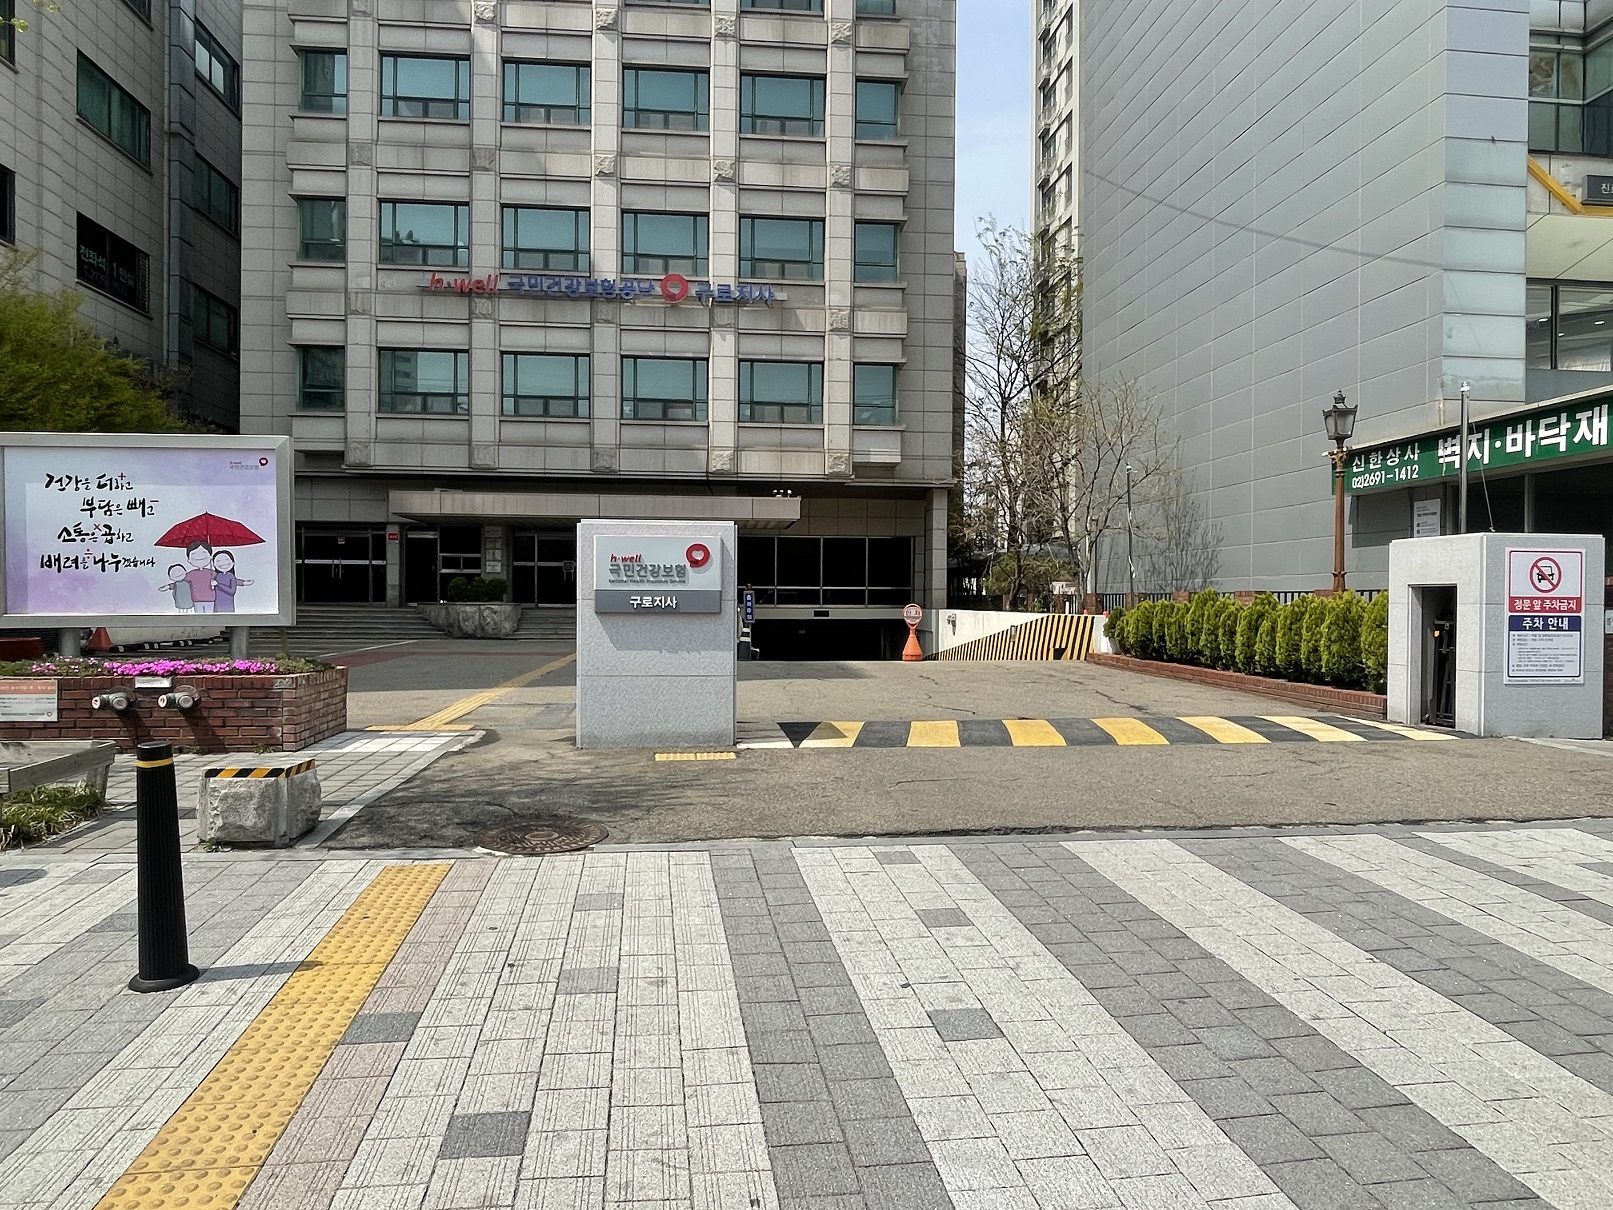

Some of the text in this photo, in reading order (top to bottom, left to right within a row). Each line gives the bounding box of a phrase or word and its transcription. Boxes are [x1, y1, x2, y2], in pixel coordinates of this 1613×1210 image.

[507, 273, 655, 300] 국민건강보험공단
[695, 282, 774, 304] 구로지사
[1352, 443, 1420, 473] 신한상사
[45, 473, 133, 491] 건강을 더하고
[1351, 464, 1419, 489] 02)2691-1412
[80, 496, 155, 519] 부담은 빼고
[57, 521, 134, 544] 소통은 곱하고
[93, 552, 156, 573] 나누겠습니다
[608, 564, 687, 578] 국민건강보험
[629, 595, 678, 609] 구로지사
[1513, 599, 1577, 611] 정문 앞 주차금지
[1522, 617, 1569, 631] 주차 안내
